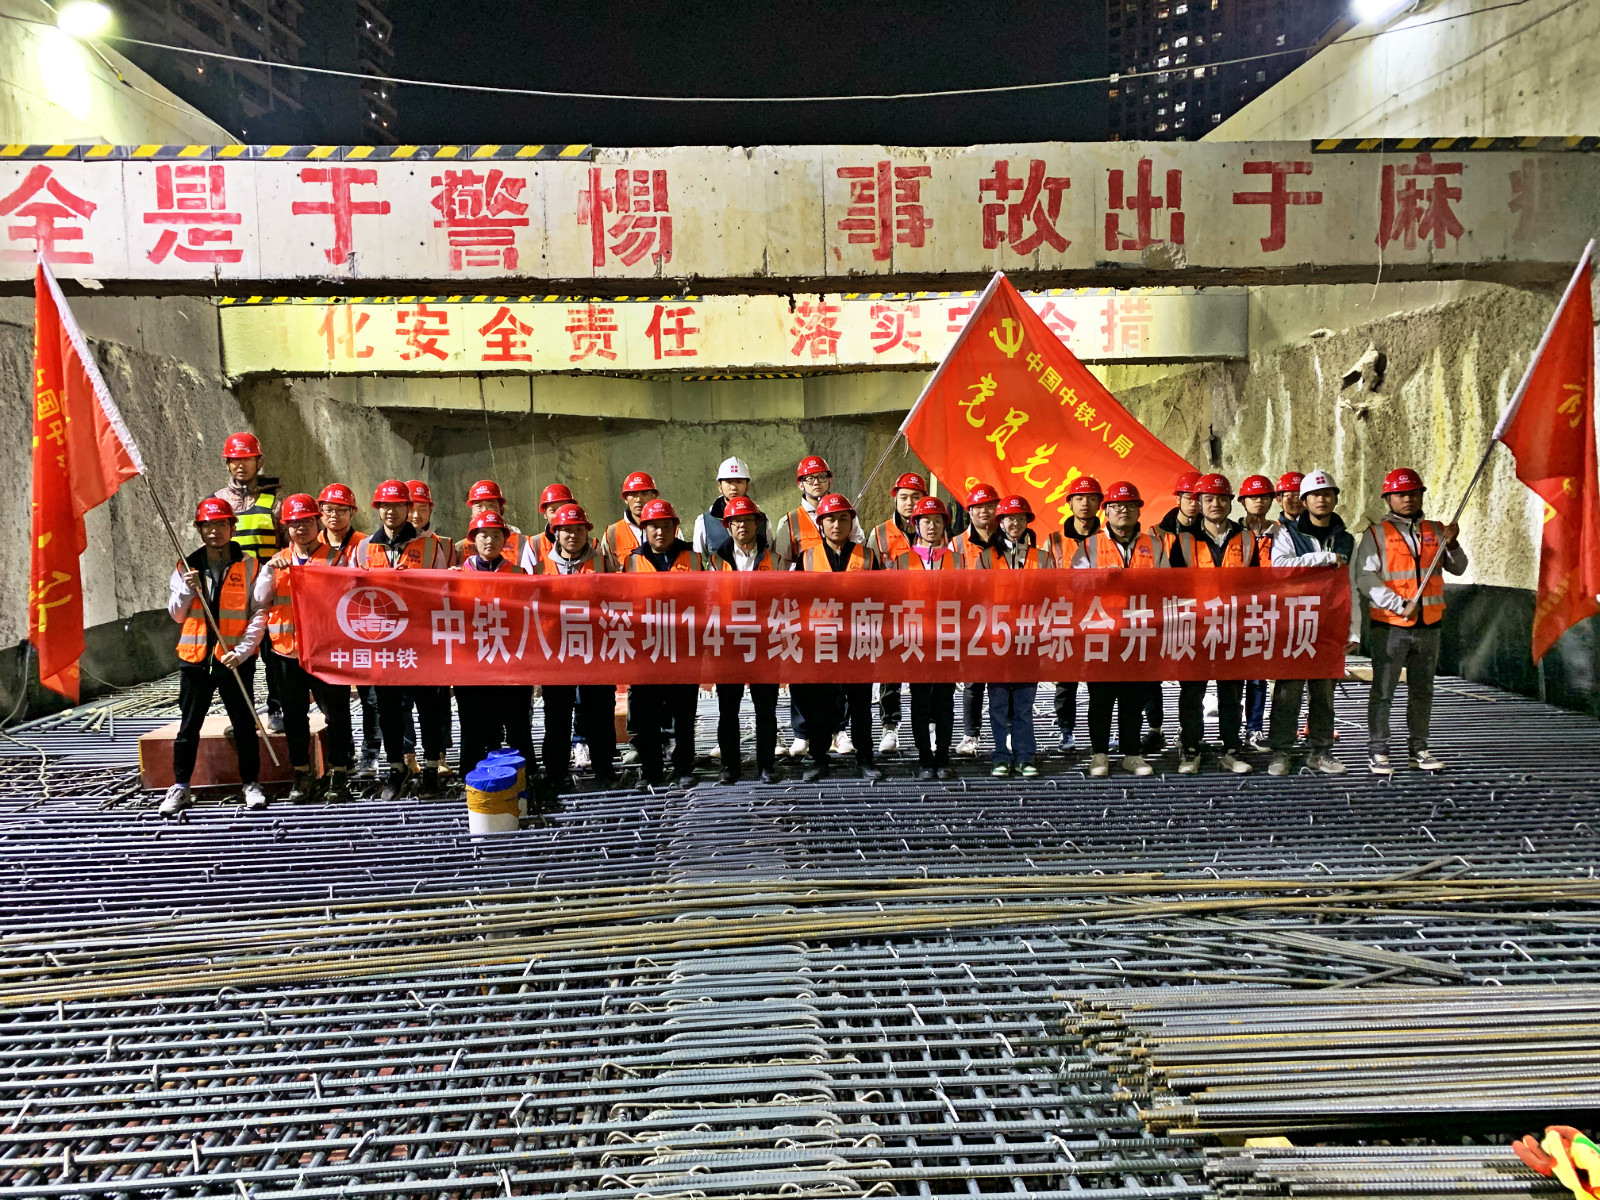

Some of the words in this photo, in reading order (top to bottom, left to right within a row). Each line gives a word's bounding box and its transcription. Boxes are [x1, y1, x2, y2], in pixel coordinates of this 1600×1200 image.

[958, 373, 1096, 524] 党员先
[1026, 351, 1135, 459] 中国中铁八局
[330, 648, 419, 669] 中国中铁
[430, 596, 1321, 665] 中铁八局深圳14号线管廊项目25#综合井顺利封顶
